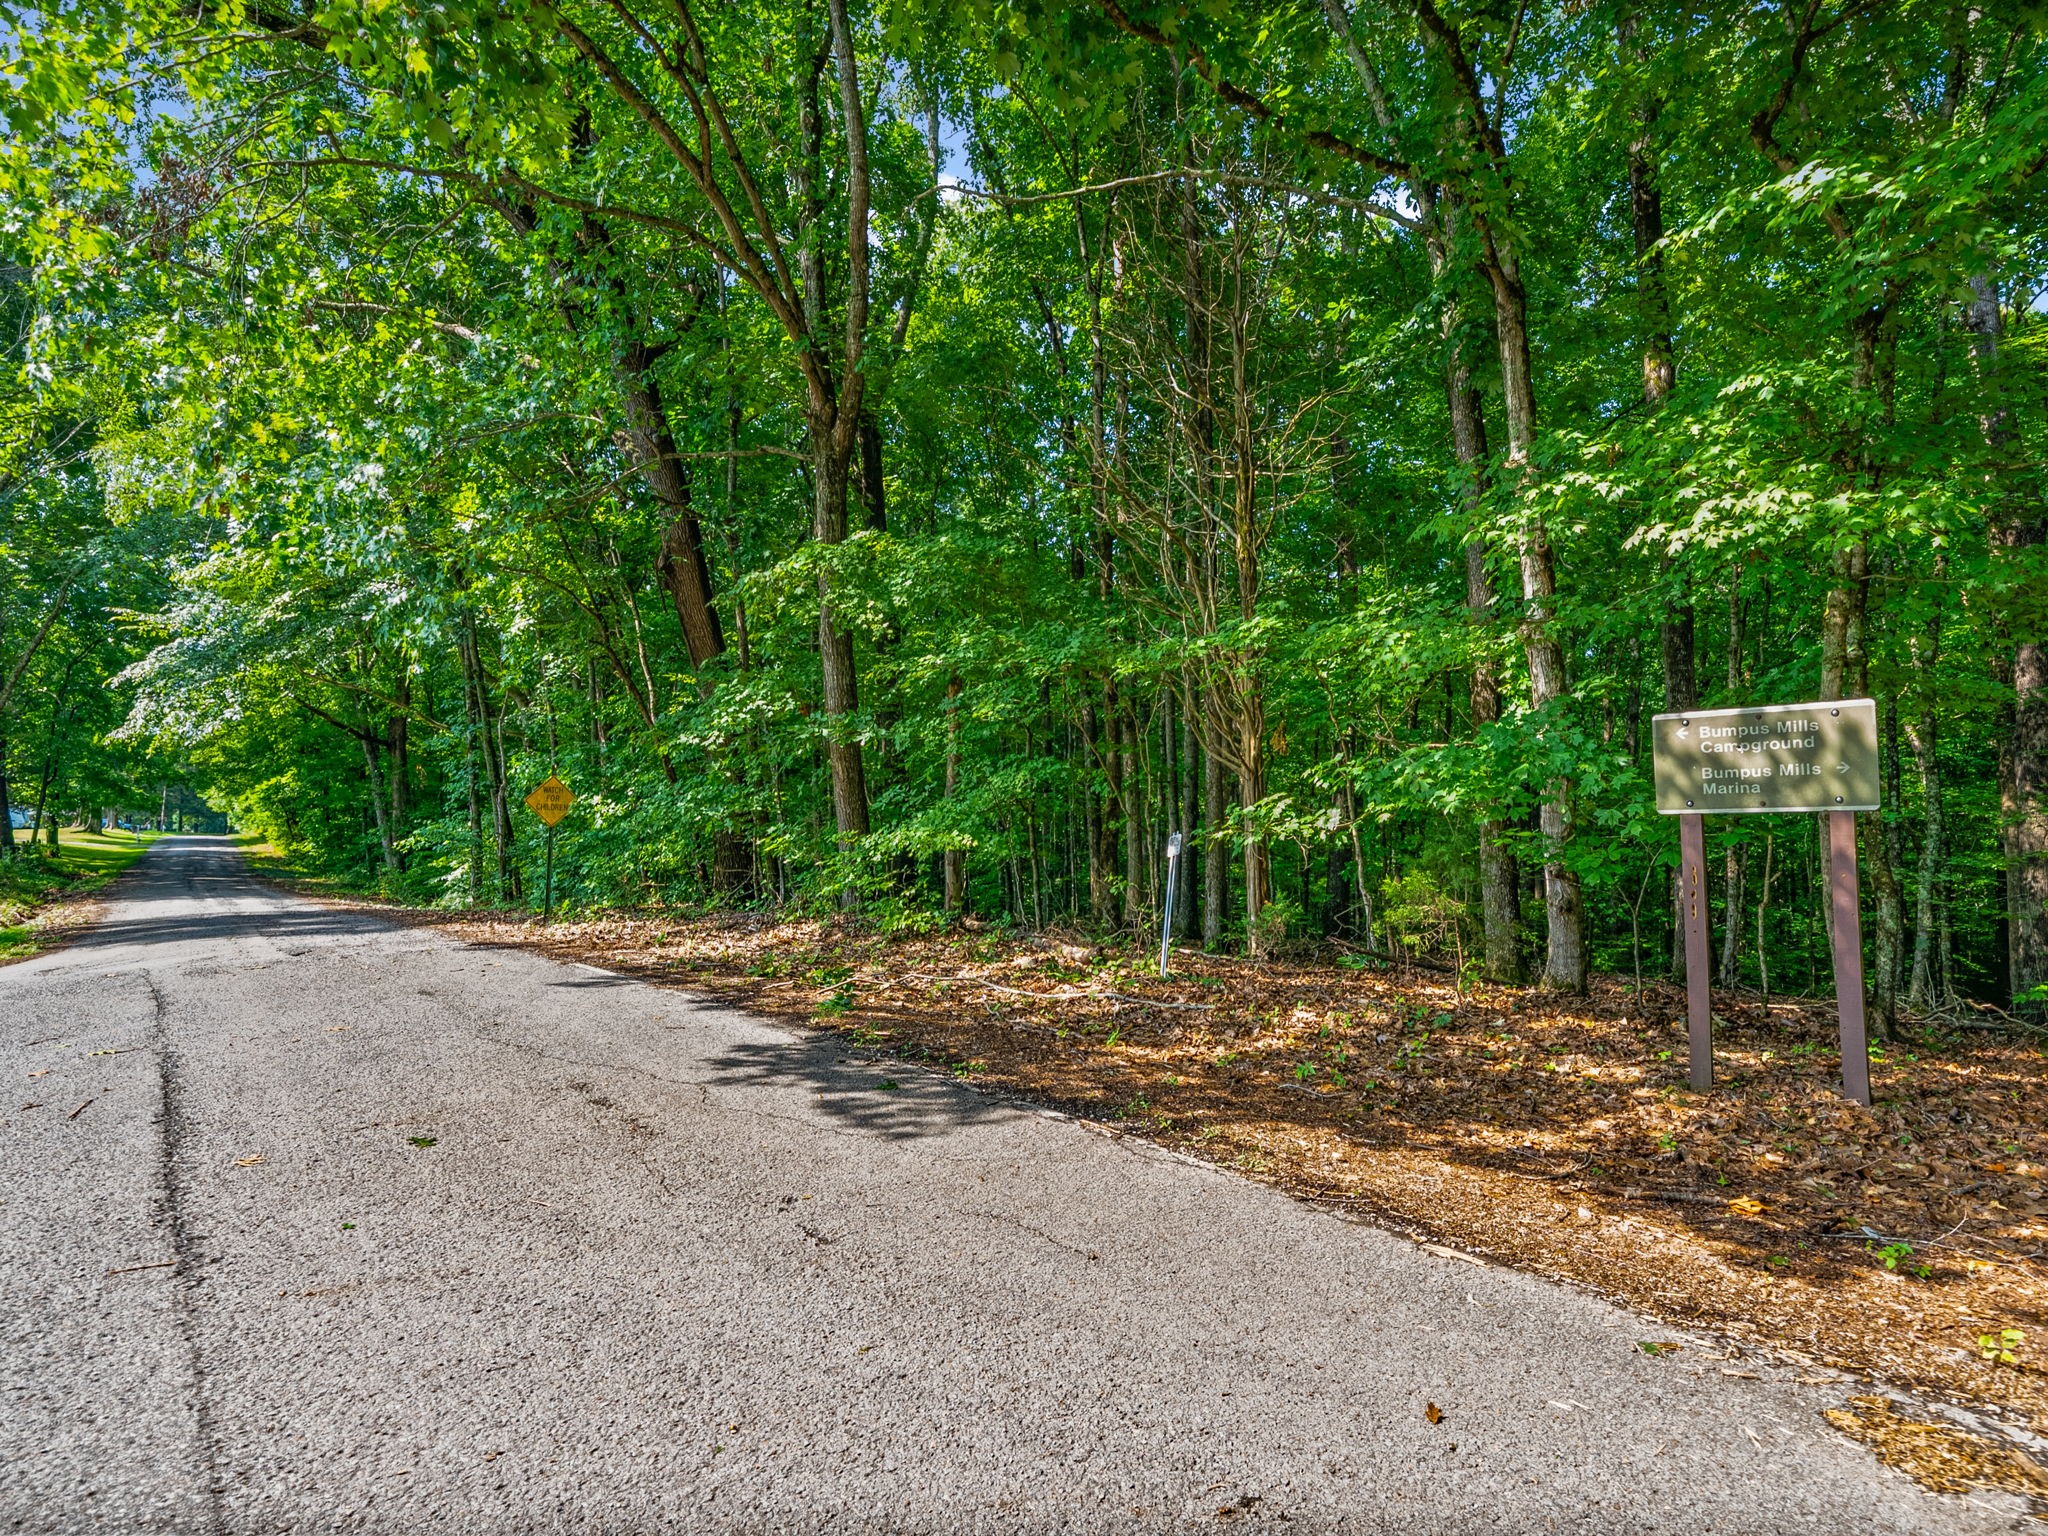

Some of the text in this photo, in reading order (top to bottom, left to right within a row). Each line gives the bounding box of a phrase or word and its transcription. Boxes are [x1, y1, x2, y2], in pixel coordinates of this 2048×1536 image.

[1699, 720, 1820, 738] Bumpus Mills
[1700, 735, 1815, 753] Campground
[1702, 763, 1821, 779] Bumpus Mills
[1703, 782, 1760, 794] Marina
[546, 794, 560, 802] FOR
